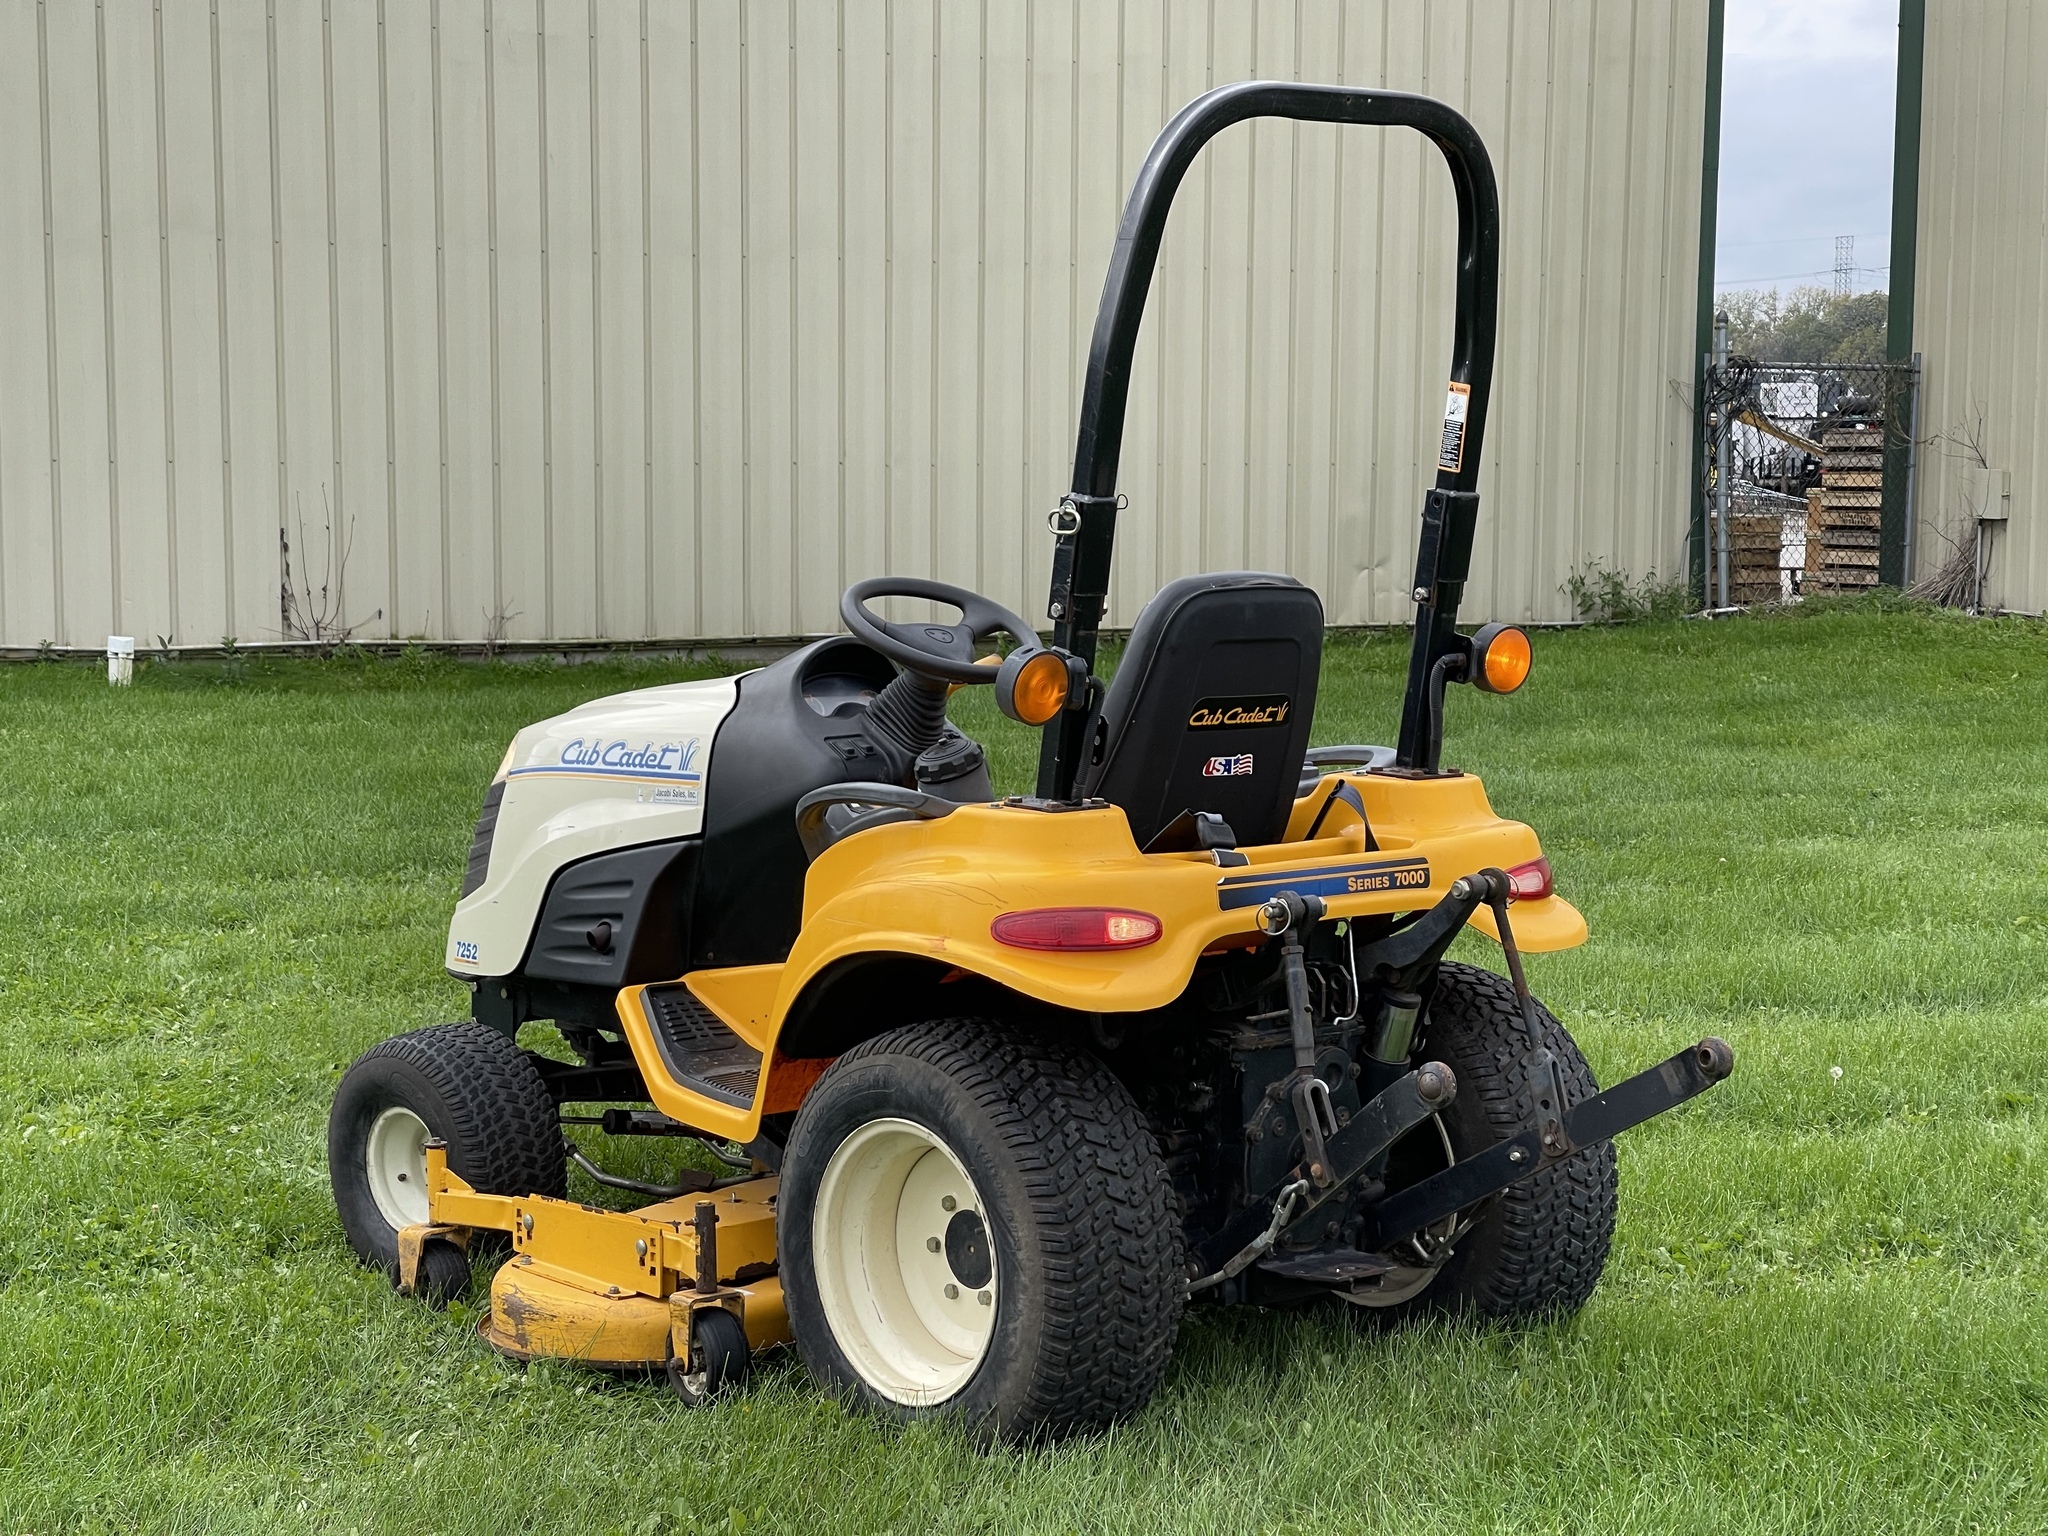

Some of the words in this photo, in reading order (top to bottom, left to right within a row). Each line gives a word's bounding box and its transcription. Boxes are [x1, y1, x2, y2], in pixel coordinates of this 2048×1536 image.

[1189, 708, 1223, 726] Cub
[1223, 706, 1278, 724] Cadet
[561, 739, 601, 766] Cub
[601, 741, 680, 770] Cadet
[1204, 757, 1234, 777] USA
[655, 788, 671, 797] Jacobi
[672, 789, 687, 799] Sales,
[688, 790, 697, 799] Inc.
[1394, 870, 1426, 886] 7000
[456, 941, 478, 961] 7252
